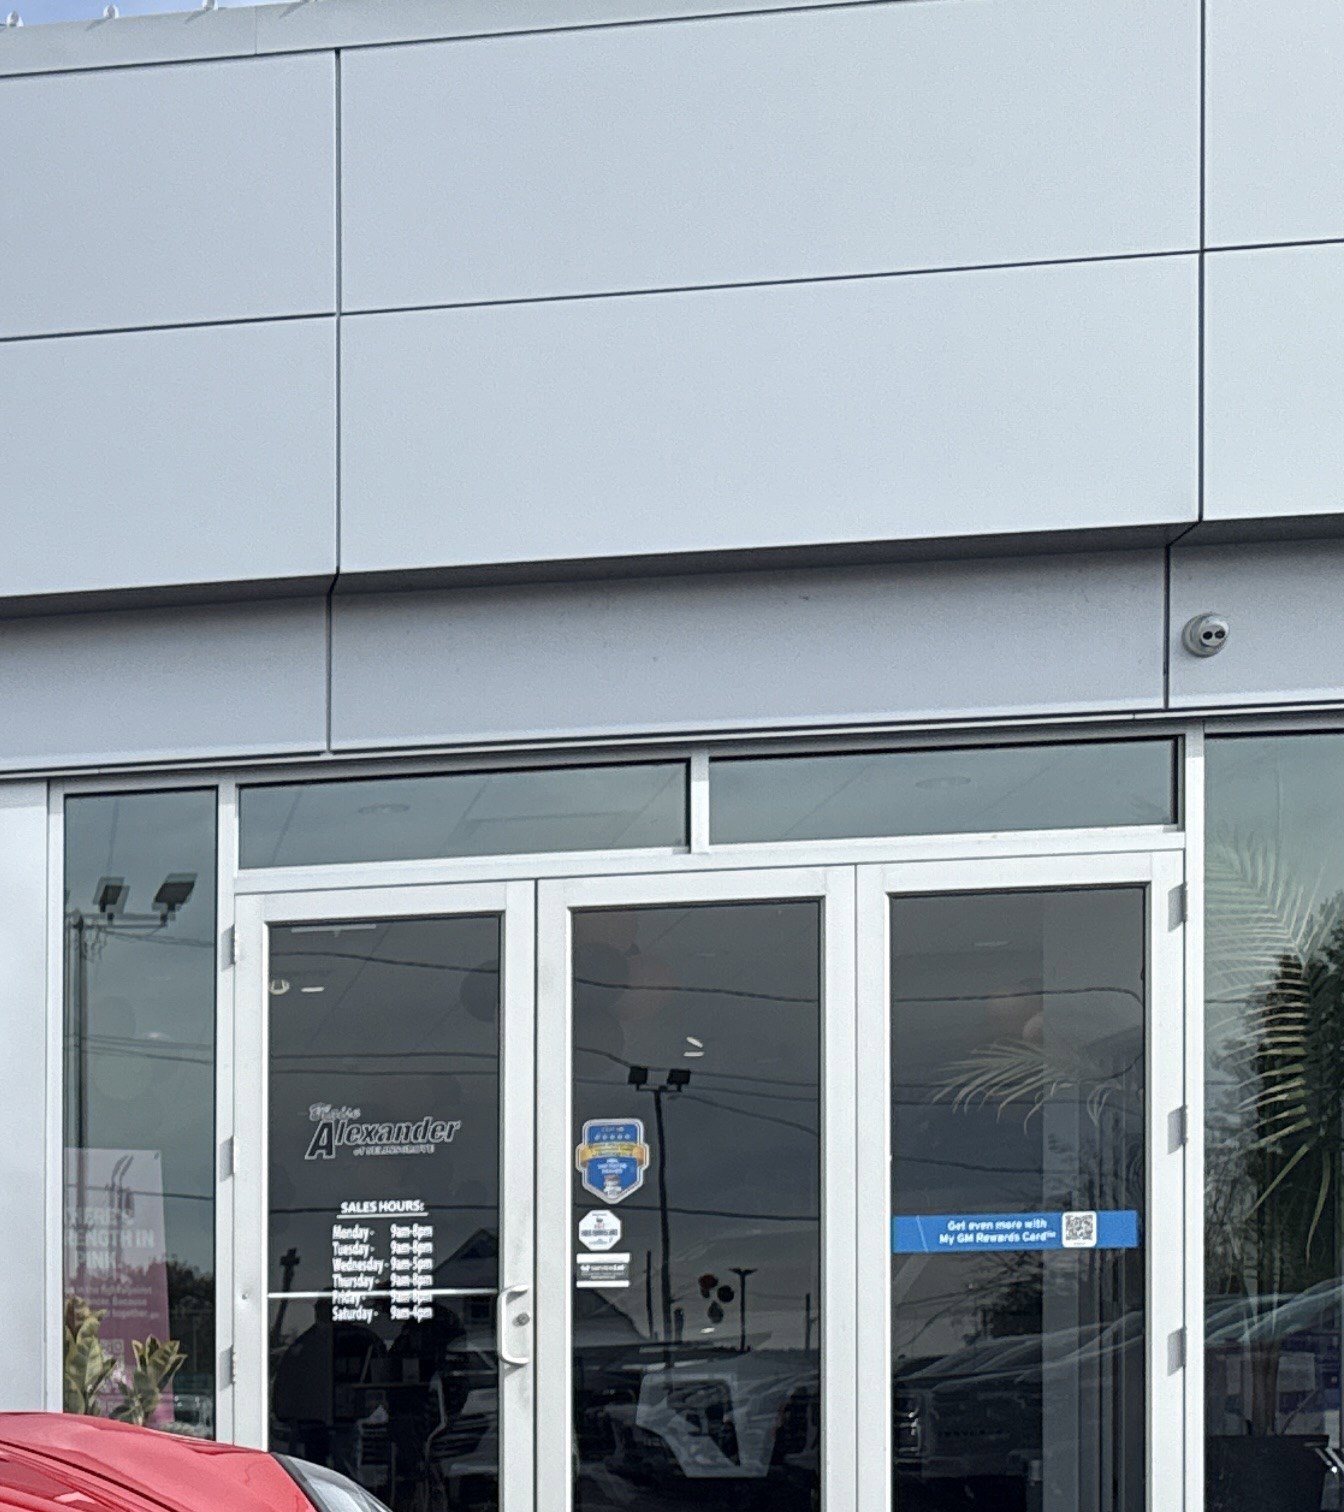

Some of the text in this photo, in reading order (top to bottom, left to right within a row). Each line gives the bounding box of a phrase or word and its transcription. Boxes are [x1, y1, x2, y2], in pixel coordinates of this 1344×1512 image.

[305, 1116, 461, 1159] Alexander
[341, 1200, 424, 1213] SALES HOURS:
[947, 1218, 1047, 1231] Get even more with
[939, 1233, 955, 1246] My
[957, 1232, 974, 1244] GM
[976, 1232, 1020, 1243] Rewards
